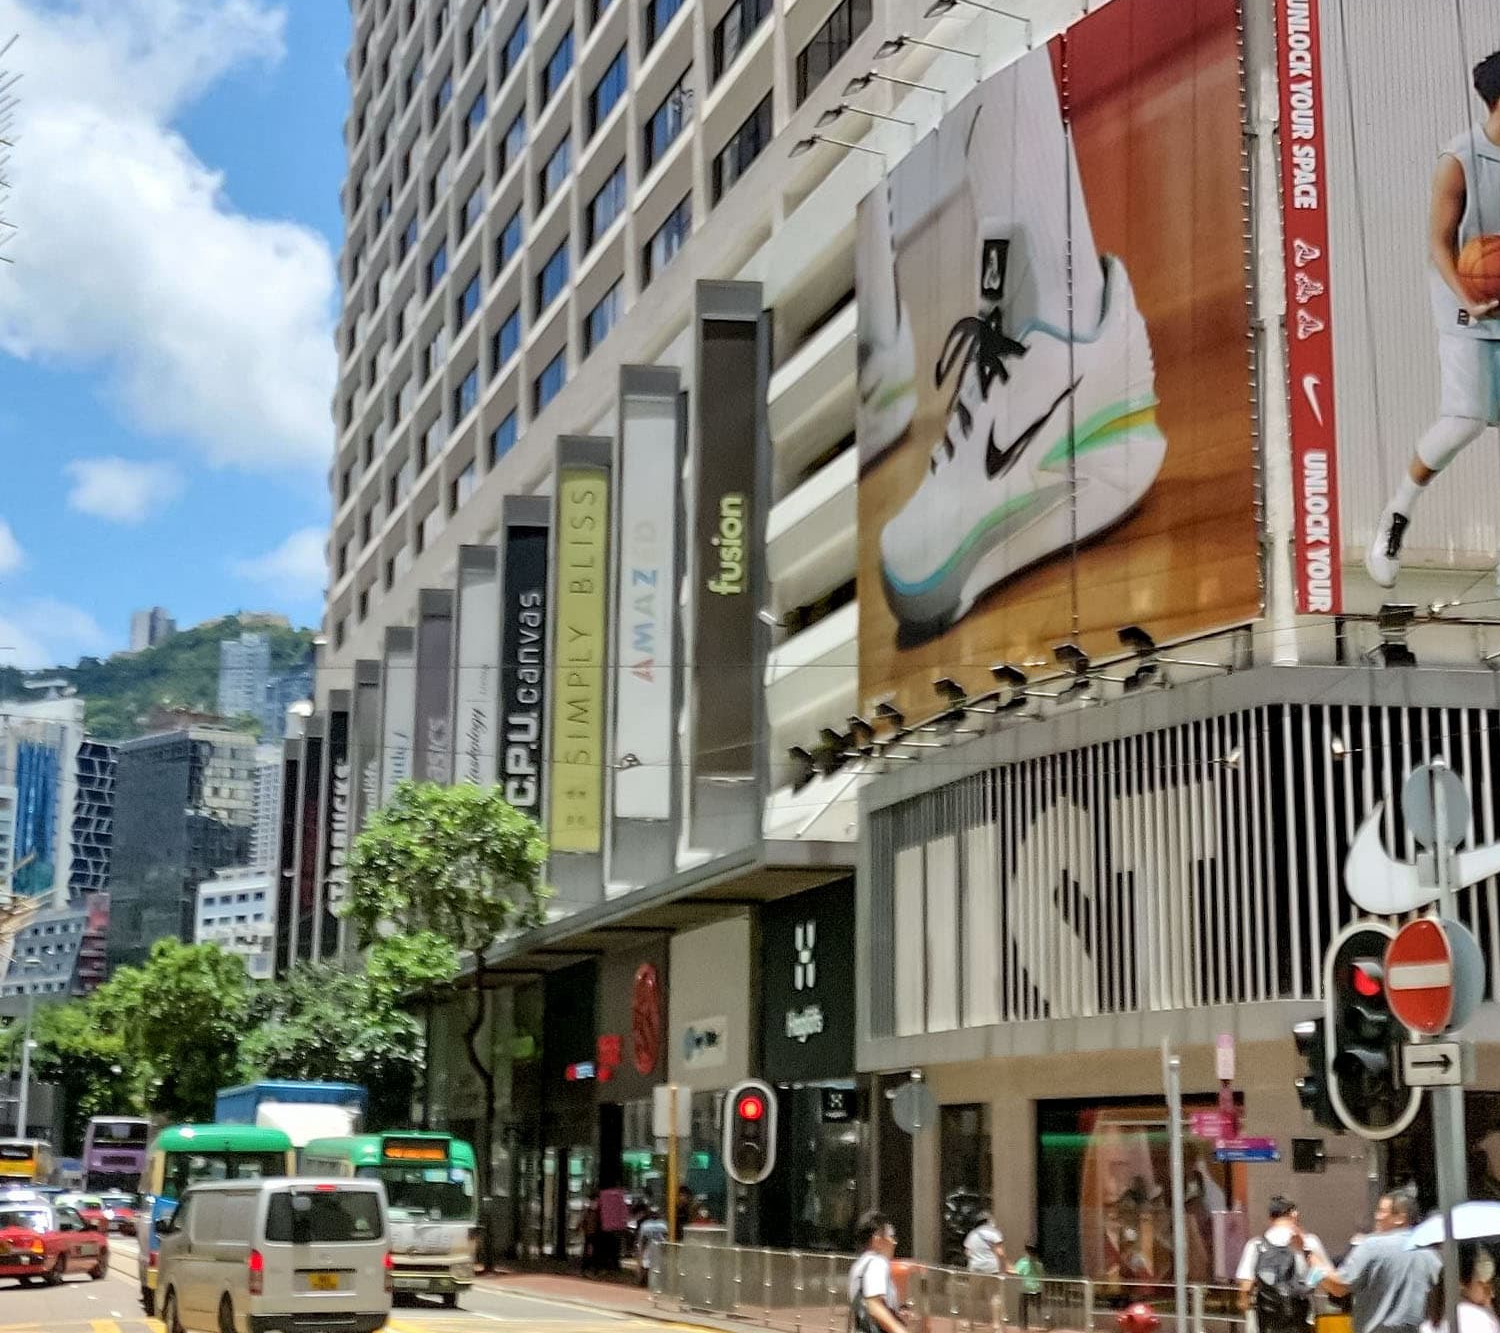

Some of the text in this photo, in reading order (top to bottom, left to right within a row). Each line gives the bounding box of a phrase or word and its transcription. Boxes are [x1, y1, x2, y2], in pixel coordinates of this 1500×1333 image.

[1290, 82, 1315, 141] YOUR
[1292, 145, 1318, 210] SPACE
[569, 490, 597, 594] BLISS
[708, 496, 744, 595] fusion
[1303, 453, 1332, 613] UNLOCK YOUR
[516, 592, 542, 704] canvas
[565, 626, 592, 765] SIMPLY
